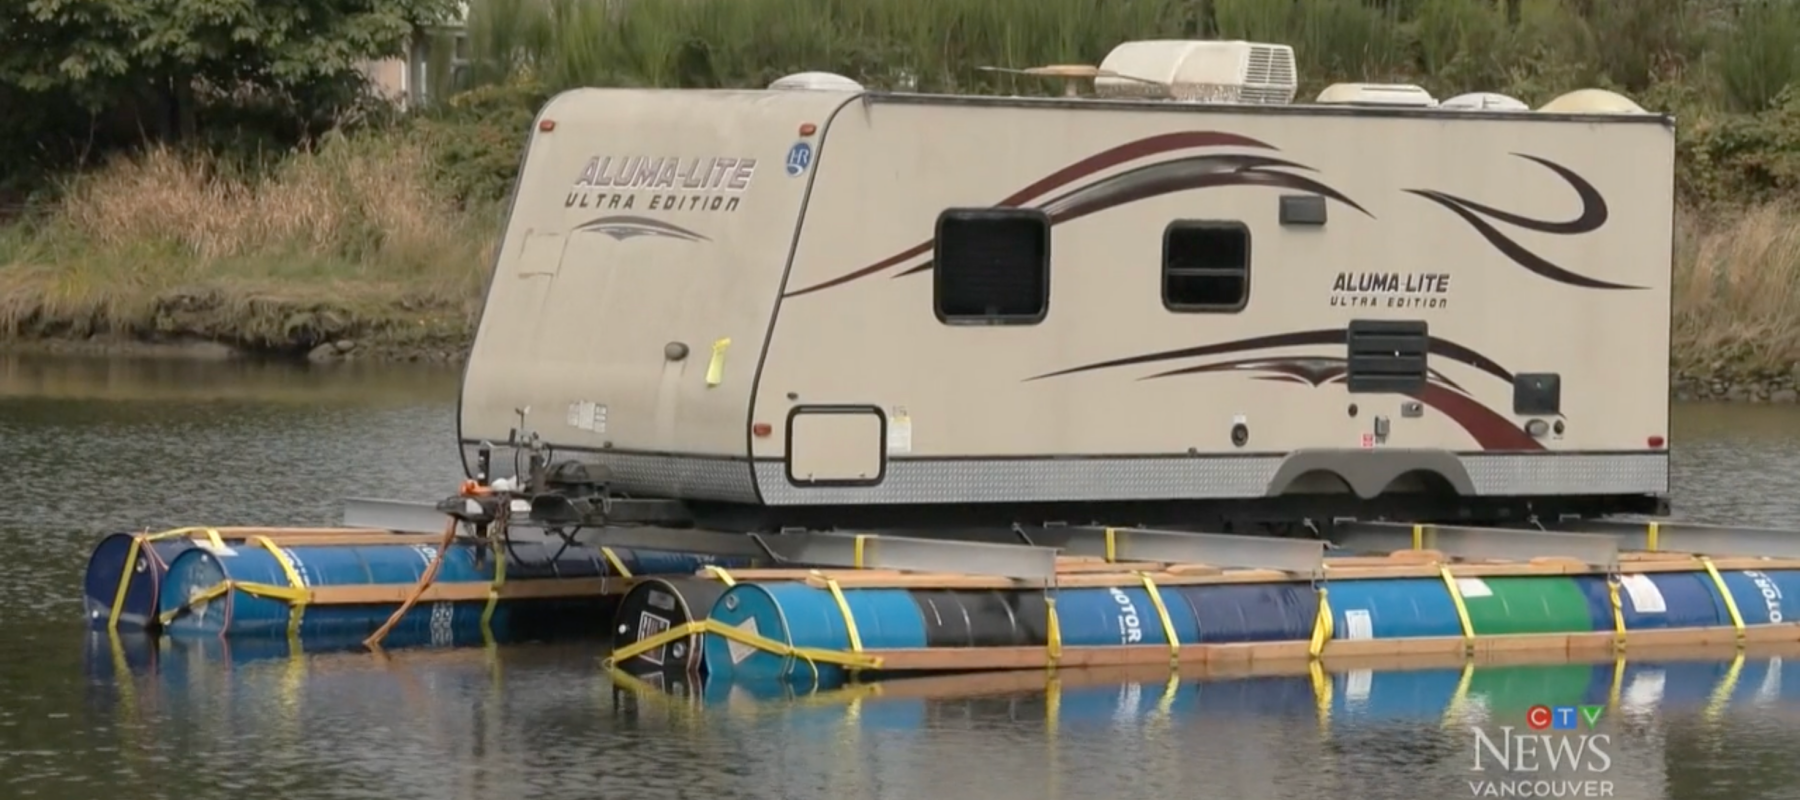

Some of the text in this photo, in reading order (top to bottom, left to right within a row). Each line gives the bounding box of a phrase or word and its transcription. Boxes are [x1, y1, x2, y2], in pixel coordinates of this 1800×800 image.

[575, 156, 758, 192] ALUMA-LITE
[565, 193, 740, 211] ULTRA EDITION
[1333, 272, 1450, 293] ALUMA-LITE
[1330, 296, 1377, 307] ULTRA
